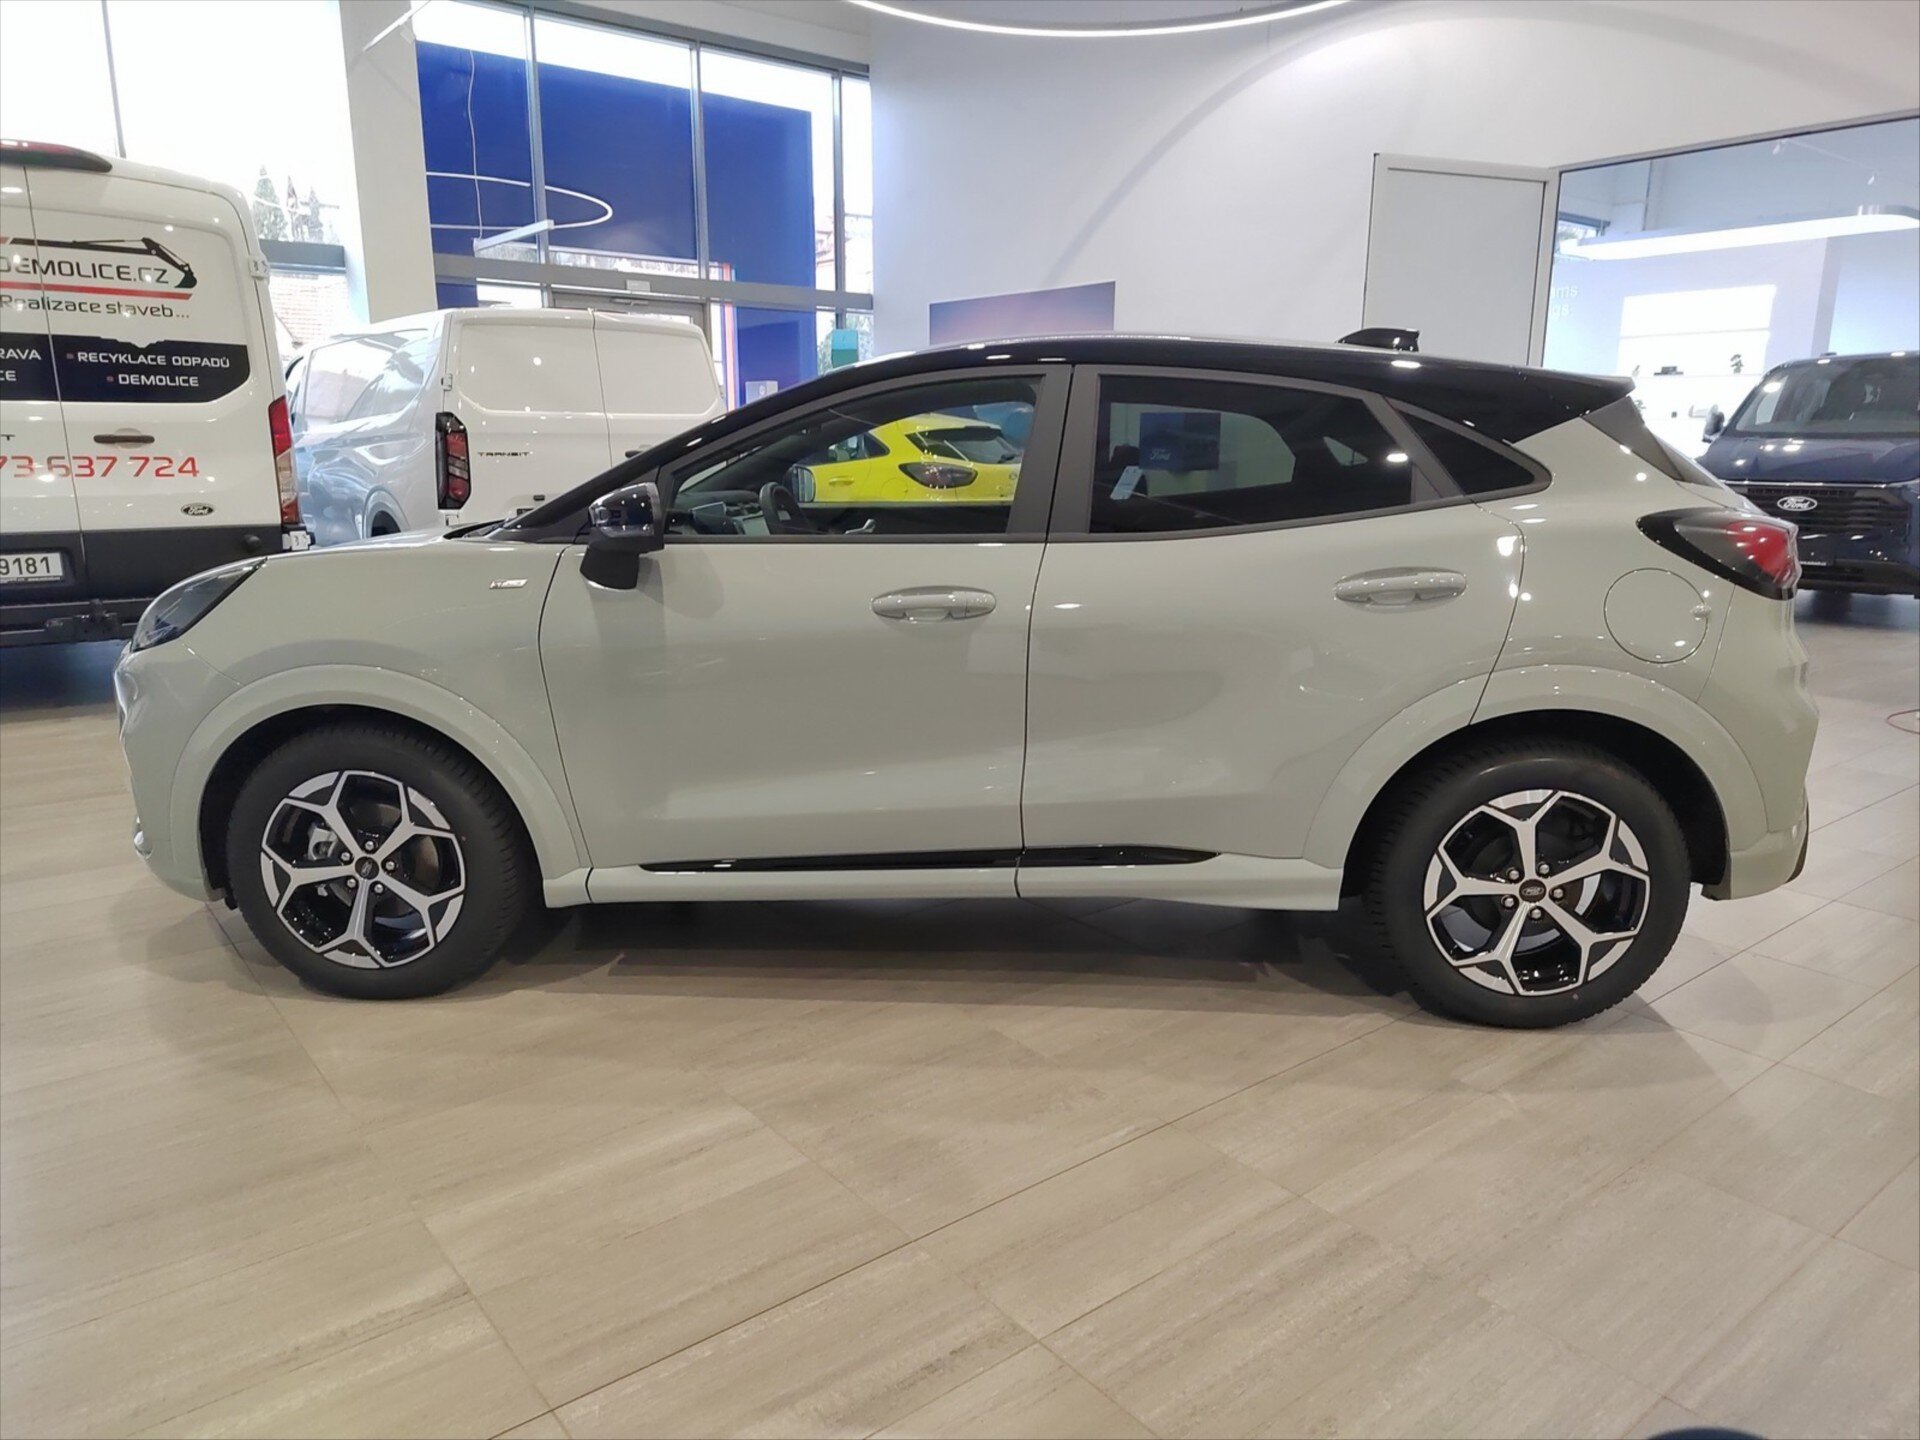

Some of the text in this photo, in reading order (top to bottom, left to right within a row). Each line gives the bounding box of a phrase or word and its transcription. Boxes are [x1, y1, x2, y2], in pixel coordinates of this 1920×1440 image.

[77, 352, 230, 368] RECYKLACE ODPADŮ
[118, 373, 200, 387] DEMOLICE
[46, 455, 118, 477] 637
[129, 456, 199, 477] 724
[1781, 497, 1813, 510] Ford
[0, 556, 51, 576] 9181
